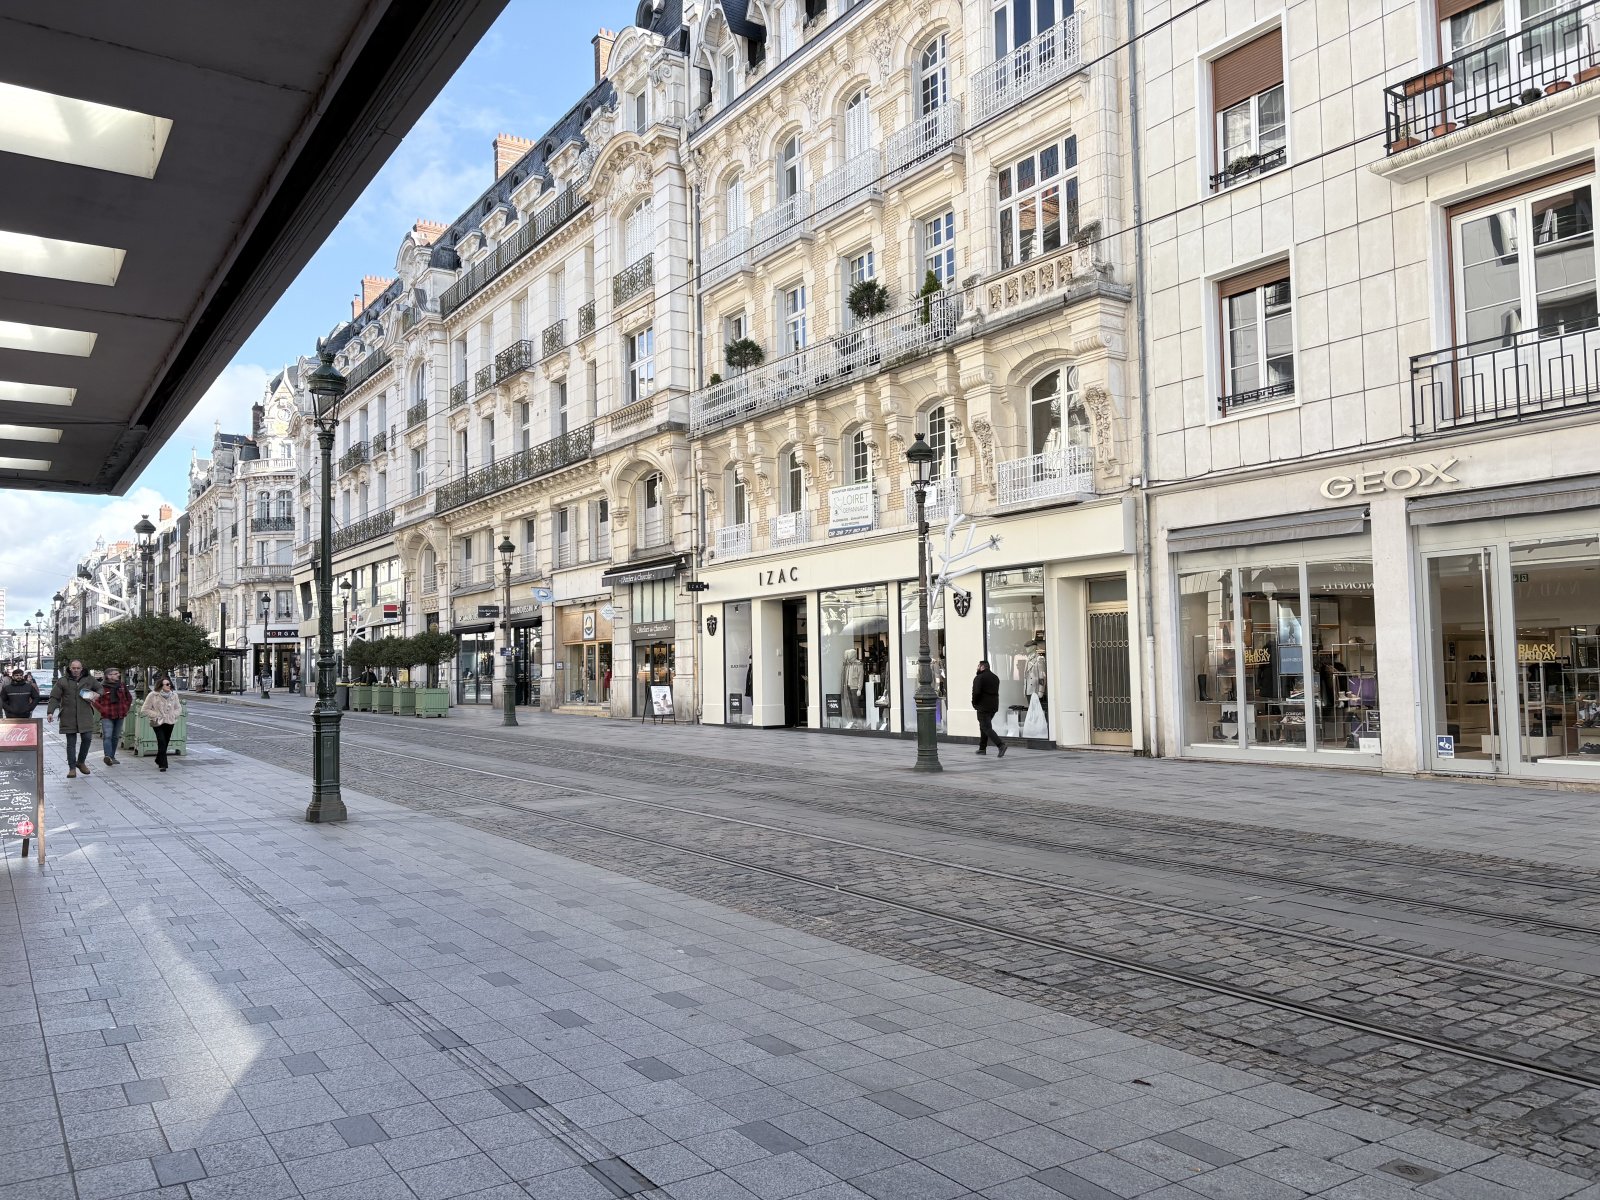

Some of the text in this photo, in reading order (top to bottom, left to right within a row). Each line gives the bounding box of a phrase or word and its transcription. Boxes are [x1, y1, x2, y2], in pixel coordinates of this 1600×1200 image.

[1320, 459, 1459, 499] GEOX
[843, 493, 869, 505] LOIRET
[759, 567, 798, 586] IZAC
[1244, 648, 1269, 657] BLACK
[1518, 644, 1555, 652] BLACK
[1244, 654, 1270, 663] FRIDAY
[1518, 651, 1557, 660] FRIDAY
[3, 726, 30, 742] Cola
